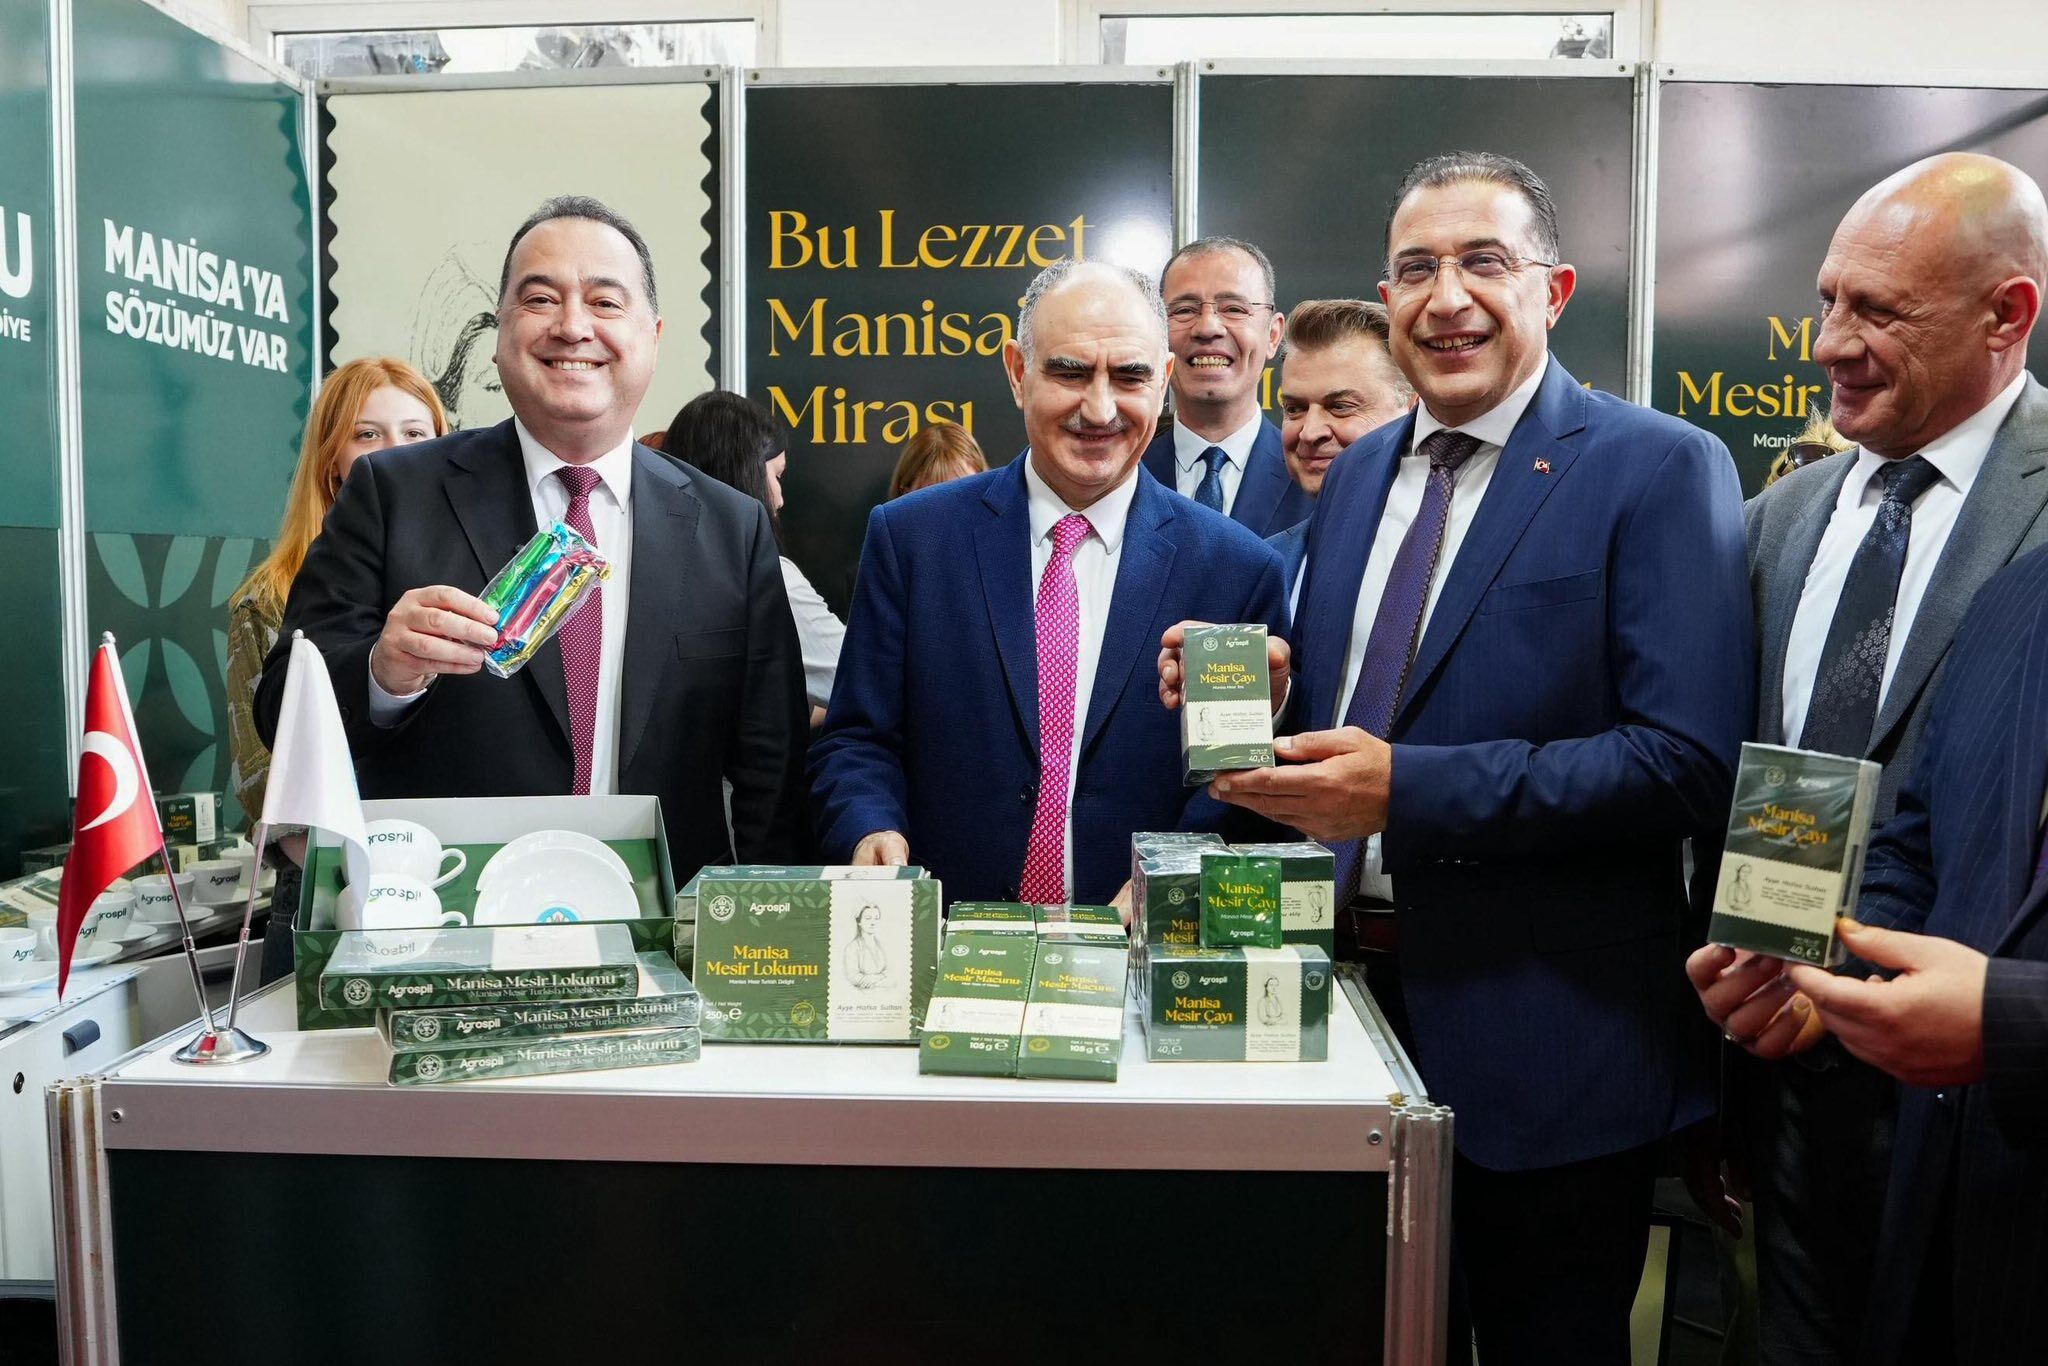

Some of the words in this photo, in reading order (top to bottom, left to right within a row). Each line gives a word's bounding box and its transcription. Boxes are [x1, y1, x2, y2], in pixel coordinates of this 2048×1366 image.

[768, 210, 858, 268] Bu
[879, 210, 1096, 268] Lezzet
[104, 218, 289, 324] MANİSA'YA
[0, 308, 31, 342] İYE
[106, 288, 234, 361] SÖZÜMÜZ
[237, 326, 288, 373] VAR
[1677, 371, 1822, 417] Mesir
[766, 386, 974, 444] Mirası
[1753, 433, 1797, 448] Manis
[1207, 663, 1246, 673] Manisa
[1200, 674, 1230, 684] Mesir
[1231, 673, 1256, 685] Çayı
[1763, 803, 1816, 825] Manisa
[1748, 816, 1790, 836] Mesir
[1792, 825, 1829, 845] Çayı
[367, 832, 413, 846] rospil
[1218, 882, 1264, 895] Manisa
[141, 894, 174, 905] Agrosp
[1208, 896, 1244, 908] Mesir
[1248, 896, 1277, 912] Çayı
[749, 902, 791, 915] Agrospil
[1172, 920, 1199, 931] Man
[1163, 932, 1197, 944] Mesir
[733, 945, 790, 960] Manisa
[706, 961, 751, 976] Mesir
[754, 960, 819, 976] Lokumu
[964, 966, 1002, 976] Manisa
[388, 984, 433, 998] Agrospil
[447, 977, 502, 990] Manisa
[505, 975, 549, 988] Mesir
[552, 973, 616, 986] Lokumu
[943, 973, 975, 982] Mesir
[976, 975, 1020, 985] Macunu
[1039, 980, 1070, 989] Mesir
[1199, 976, 1228, 985] Agrospil
[1175, 996, 1221, 1009] Manisa
[456, 1018, 500, 1034] Agrospil
[513, 1009, 568, 1024] Manisa
[571, 1006, 613, 1019] Mesir
[617, 1002, 678, 1017] Lokumu
[1165, 1009, 1201, 1022] Mesir
[1204, 1010, 1233, 1024] Çayı
[460, 1056, 504, 1071] Agrospil
[516, 1047, 571, 1062] Manisa
[573, 1042, 616, 1056] Mesir
[618, 1039, 680, 1053] Lokumu
